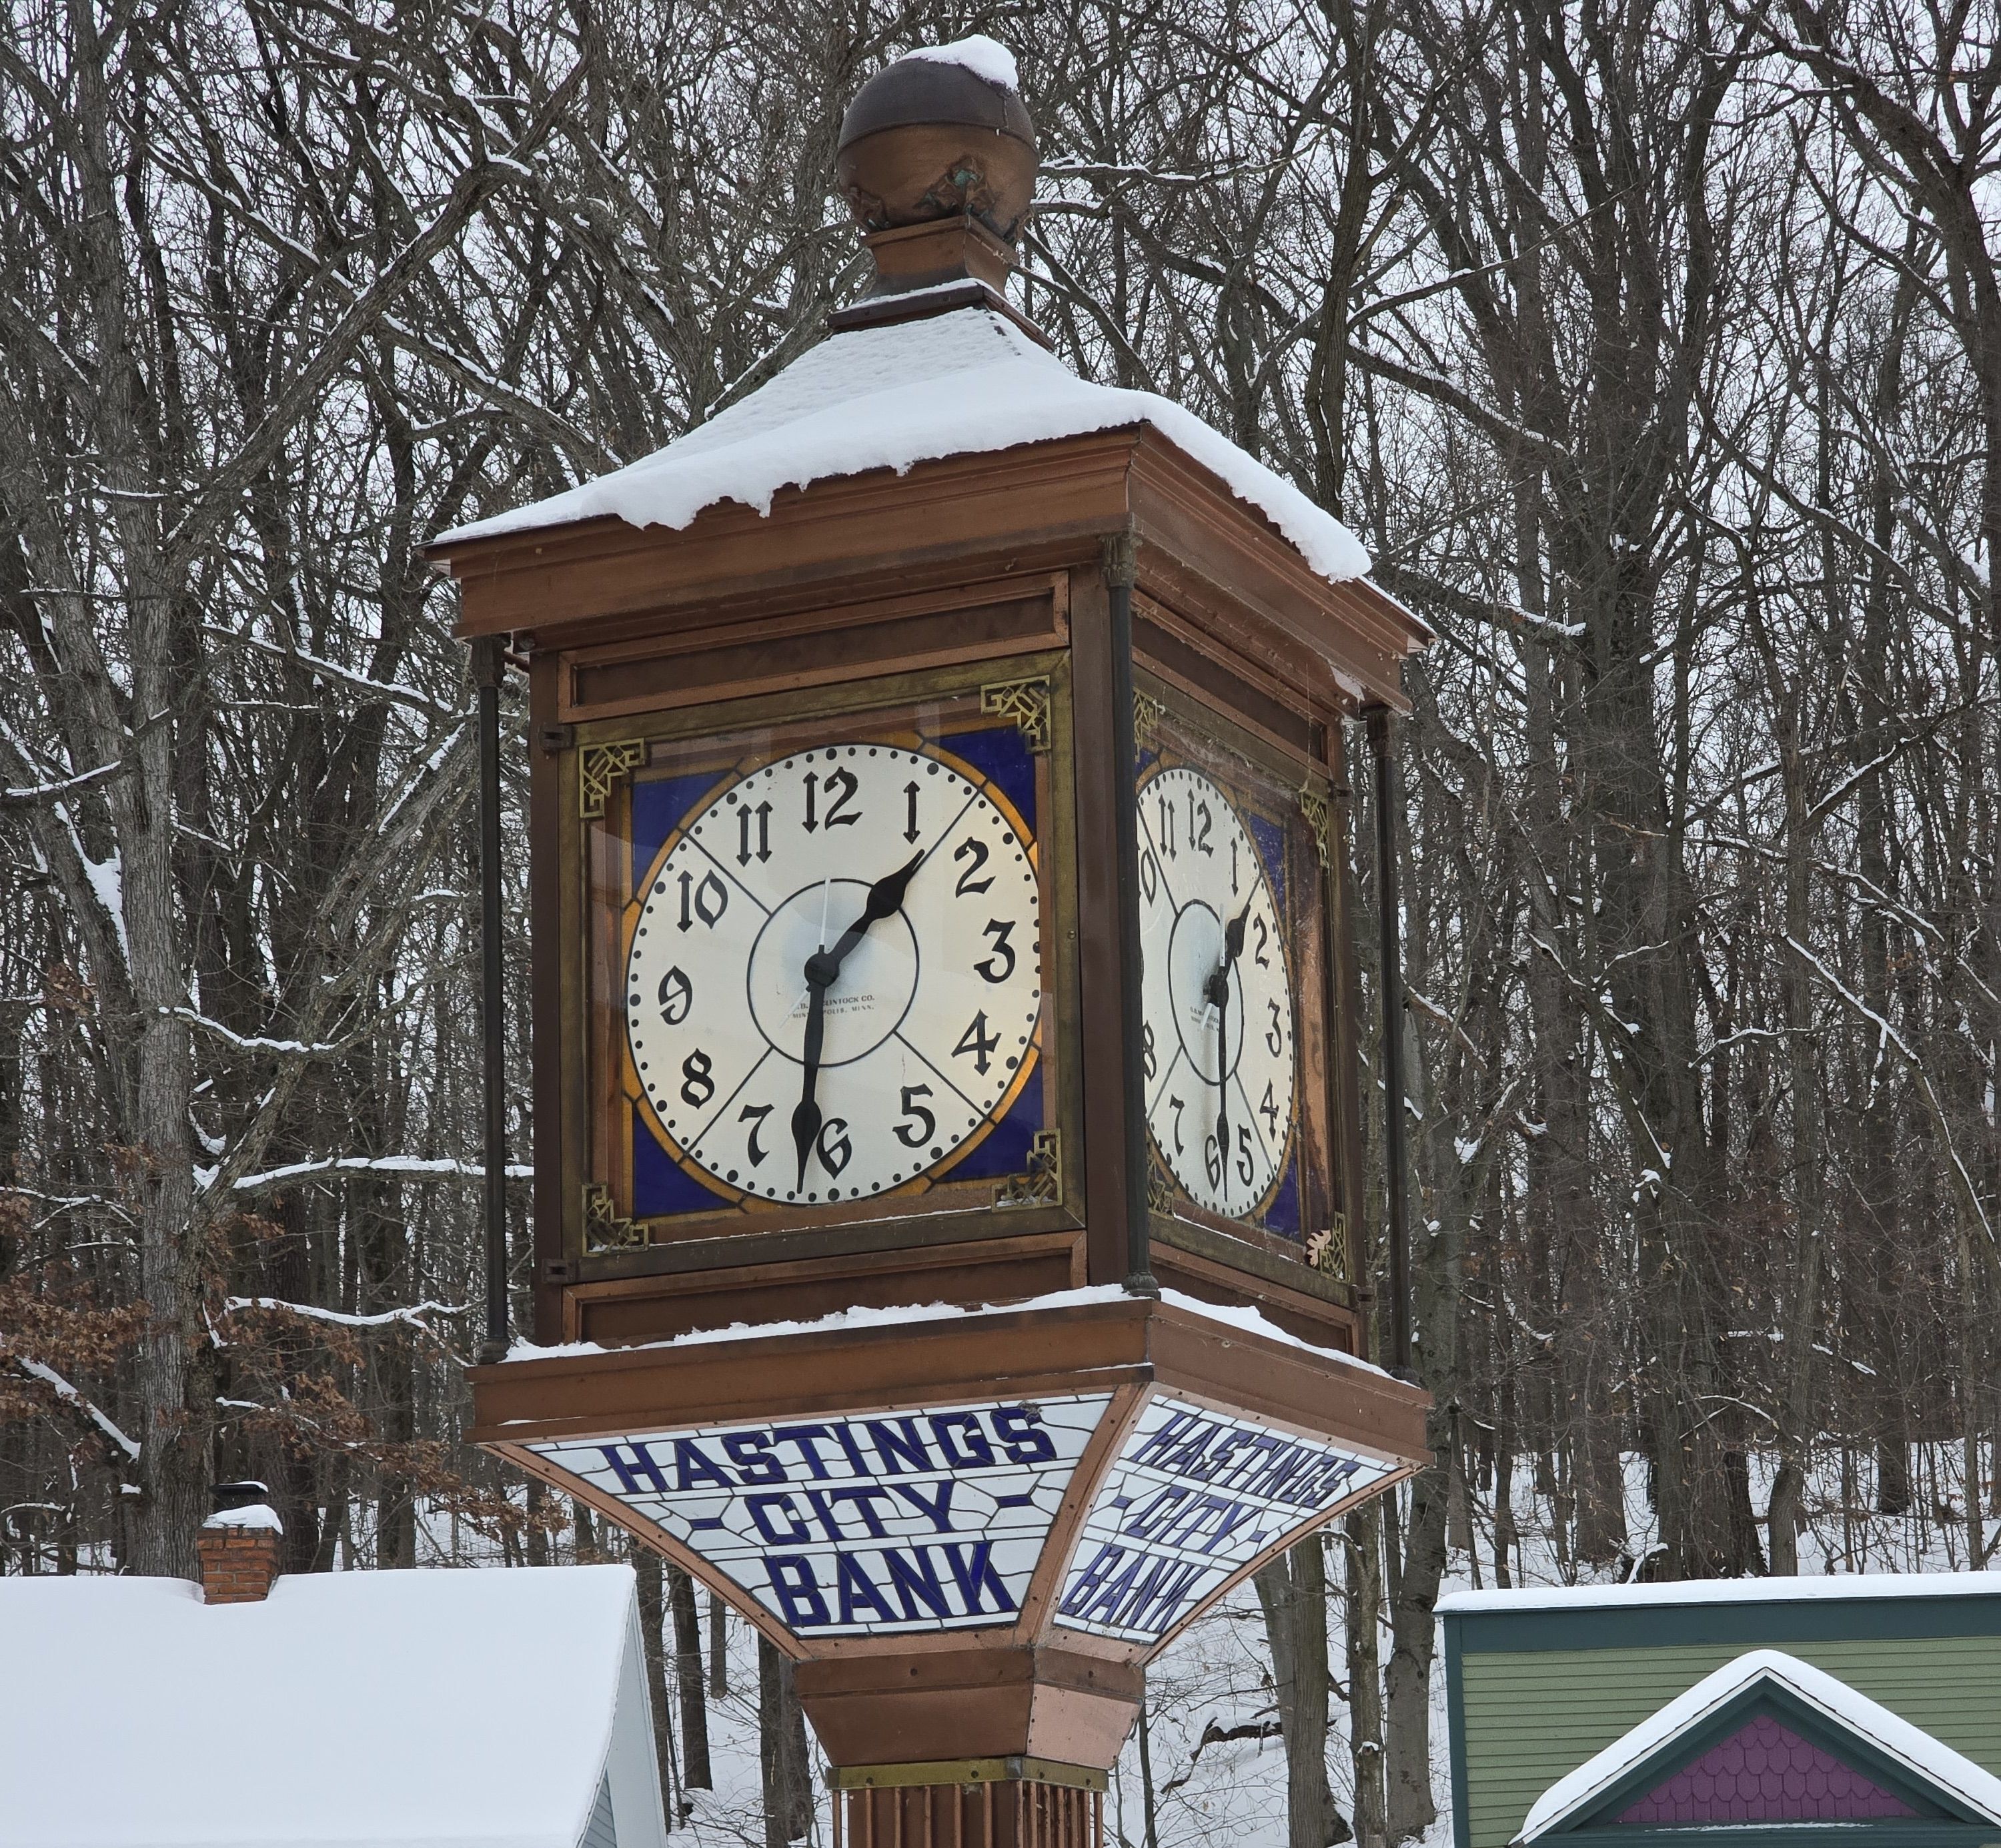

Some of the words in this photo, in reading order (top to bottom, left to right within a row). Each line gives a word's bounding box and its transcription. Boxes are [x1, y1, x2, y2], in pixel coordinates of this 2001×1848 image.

[802, 767, 862, 834] 12
[903, 781, 920, 844] 1
[1158, 794, 1177, 862] 11
[1187, 788, 1214, 858] 12
[736, 801, 773, 867] 11
[954, 837, 996, 898] 2
[1137, 843, 1156, 908] 0
[1231, 837, 1239, 897] 1
[677, 869, 728, 933] 10
[974, 919, 1016, 983] 3
[1253, 913, 1270, 970] 2
[658, 965, 692, 1025] 9
[861, 994, 875, 1002] CO.
[1267, 997, 1282, 1058] 3
[952, 1009, 1001, 1077] 4
[680, 1047, 715, 1109] 8
[1260, 1077, 1279, 1142] 4
[738, 1103, 774, 1168] 7
[892, 1083, 936, 1148] 5
[1169, 1093, 1185, 1157] 7
[816, 1118, 852, 1180] 6
[1205, 1134, 1221, 1195] 6
[1237, 1123, 1254, 1187] 5
[601, 1406, 1057, 1494] HASTINGS
[1131, 1412, 1358, 1508] HASTINGS
[744, 1480, 955, 1545] CITY
[1126, 1486, 1261, 1554] CITY
[764, 1542, 1017, 1627] BANK
[1061, 1543, 1209, 1633] BANK
